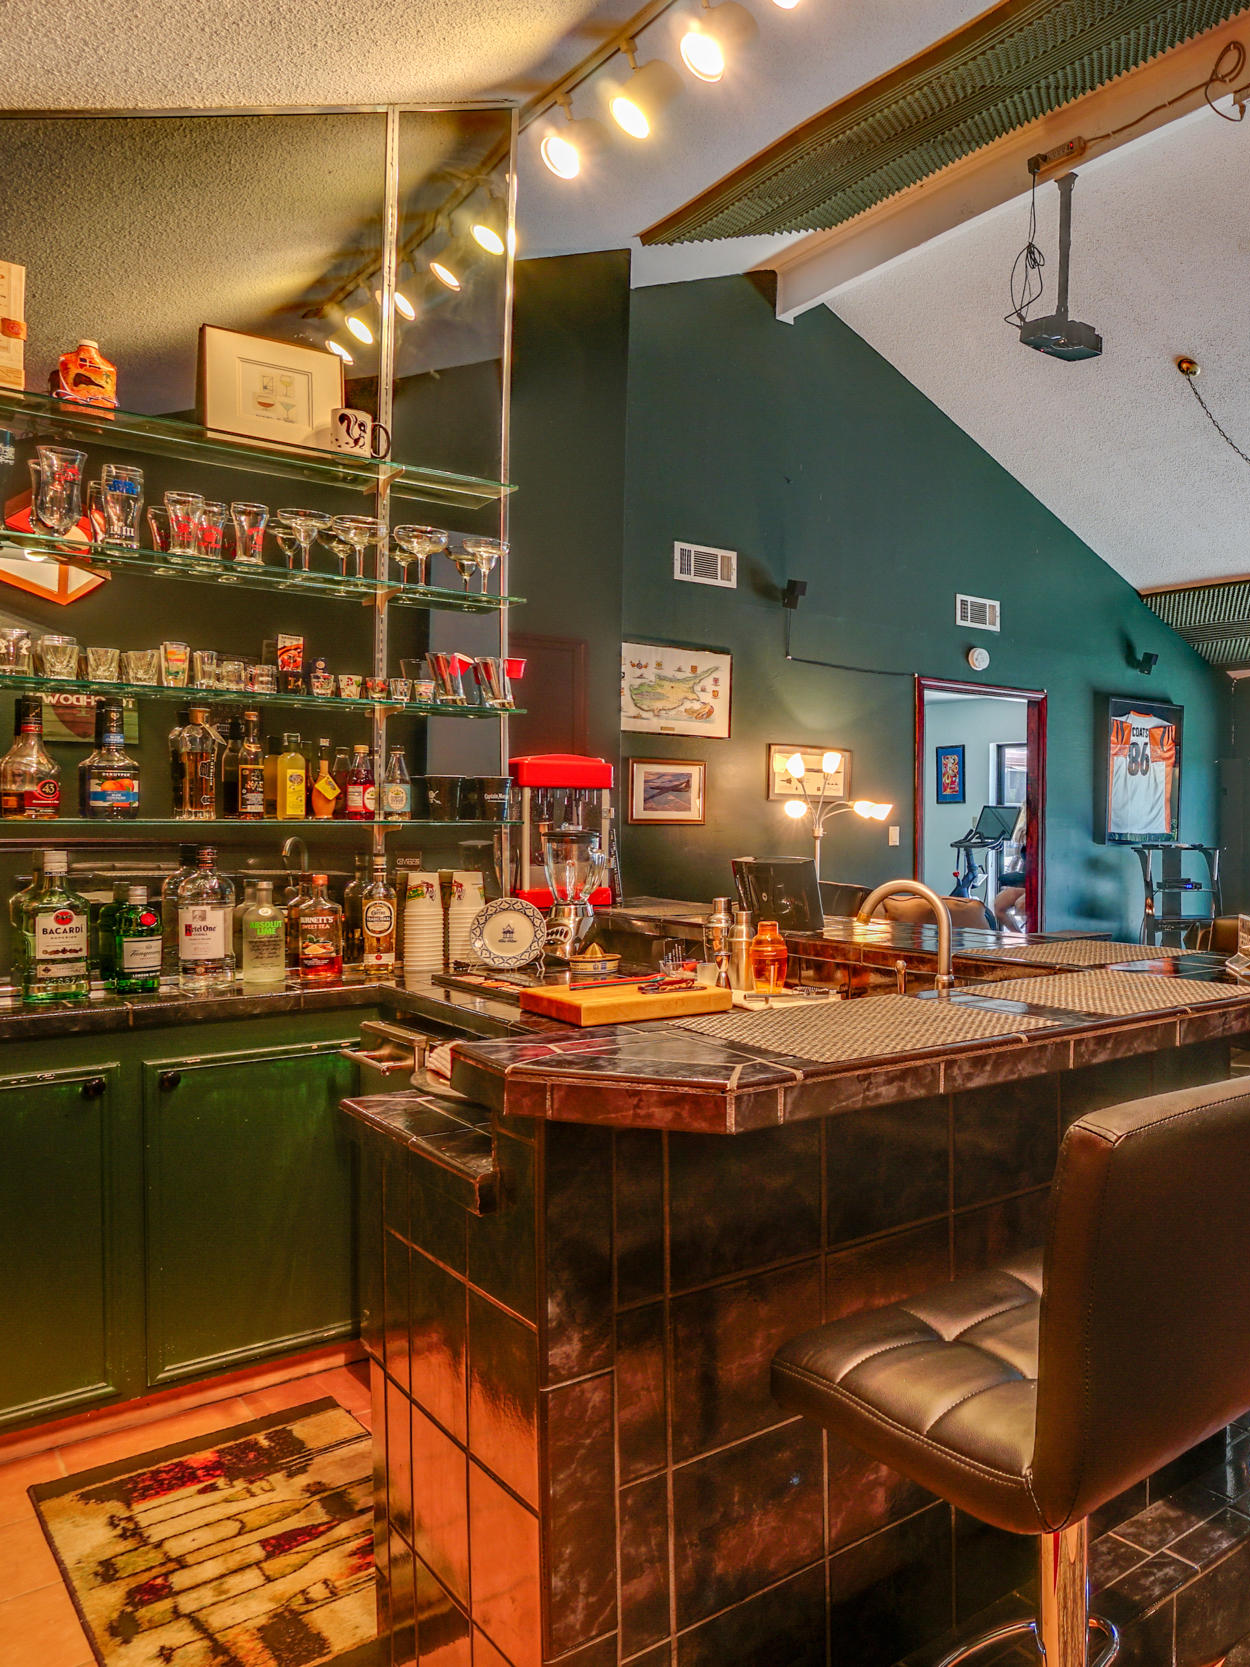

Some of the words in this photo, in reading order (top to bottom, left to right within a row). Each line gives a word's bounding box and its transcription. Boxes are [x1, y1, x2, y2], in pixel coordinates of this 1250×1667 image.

[1131, 727, 1149, 738] COATS
[1127, 742, 1150, 776] 86
[42, 783, 55, 794] 43
[257, 928, 277, 936] LIME
